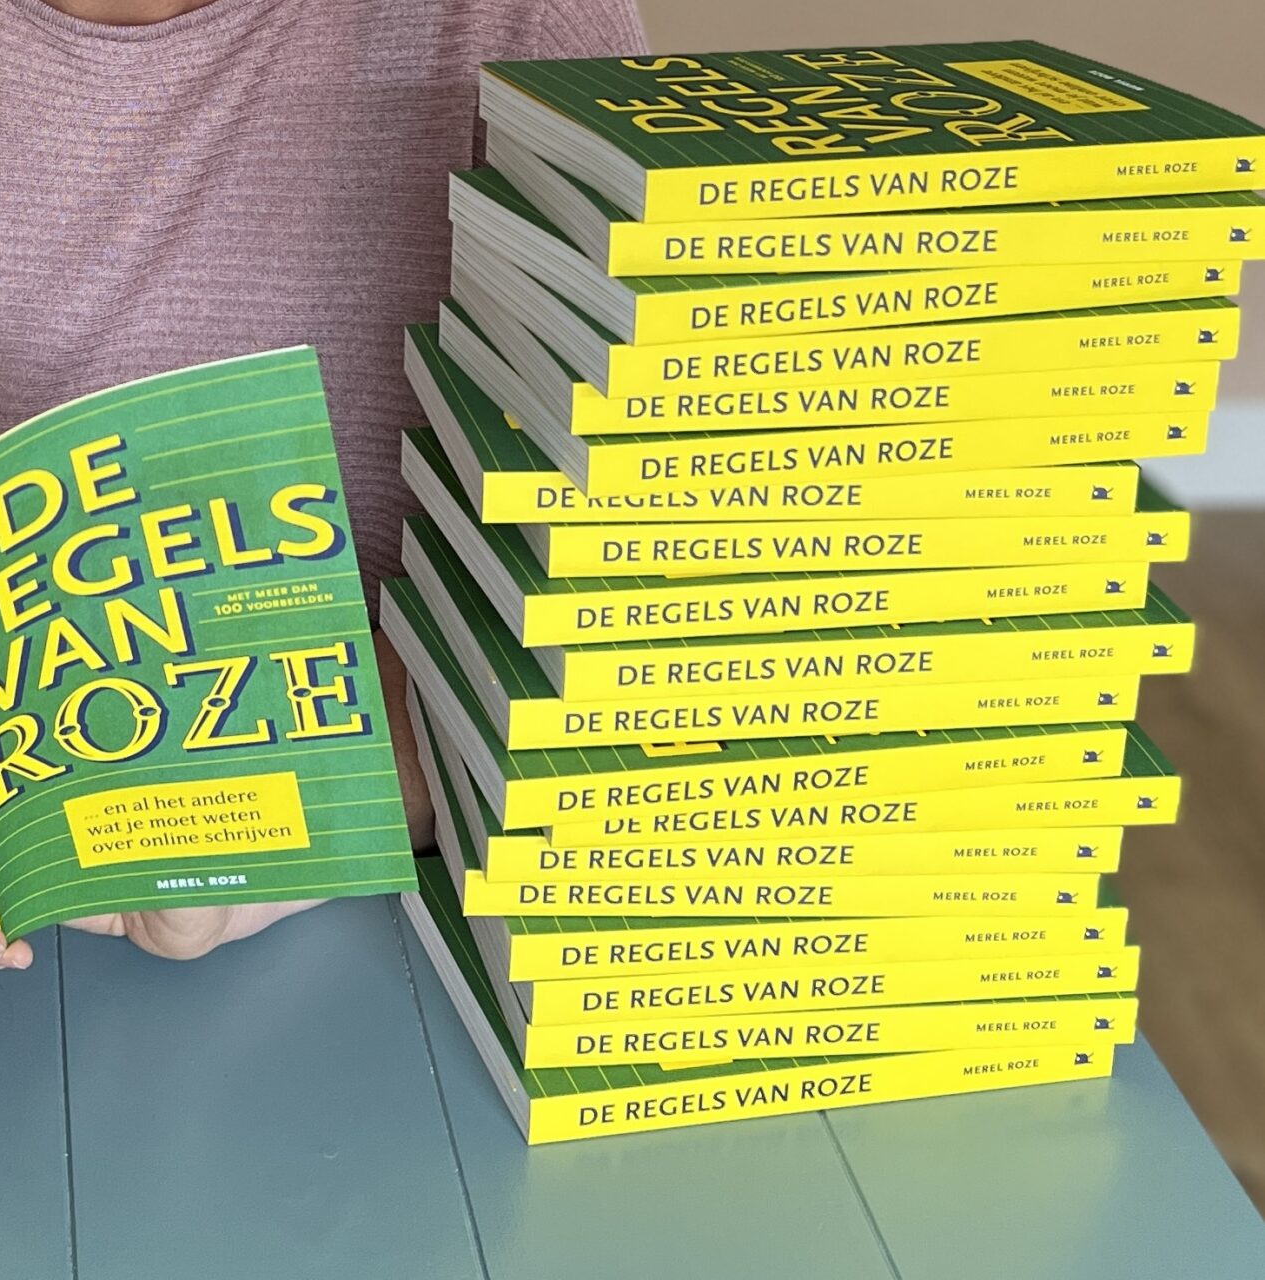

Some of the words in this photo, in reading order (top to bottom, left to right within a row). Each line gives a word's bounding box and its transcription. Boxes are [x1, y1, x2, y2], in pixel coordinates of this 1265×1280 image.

[595, 96, 725, 134] DE
[621, 56, 865, 156] REGELS
[767, 85, 932, 143] VAN
[783, 50, 1074, 146] ROZE
[699, 181, 738, 206] DE
[750, 174, 860, 203] REGELS
[870, 171, 928, 197] VAN
[941, 166, 1019, 192] ROZE
[1116, 164, 1160, 176] MEREL
[1163, 162, 1198, 174] ROZE
[665, 237, 705, 260] DE
[717, 233, 832, 259] REGELS
[842, 232, 903, 256] VAN
[917, 229, 998, 254] ROZE
[1102, 231, 1148, 243] MEREL
[1152, 230, 1189, 242] ROZE
[663, 356, 702, 381] DE
[713, 349, 823, 378] REGELS
[833, 345, 891, 370] VAN
[904, 339, 981, 366] ROZE
[1079, 336, 1122, 349] MEREL
[1126, 334, 1160, 345] ROZE
[641, 456, 679, 480] DE
[690, 448, 798, 477] REGELS
[807, 443, 865, 469] VAN
[878, 437, 954, 464] ROZE
[1049, 433, 1092, 445] MEREL
[1096, 430, 1130, 442] ROZE
[603, 540, 641, 562] DE
[653, 537, 763, 561] REGELS
[772, 536, 831, 559] VAN
[844, 534, 923, 556] ROZE
[1023, 535, 1067, 546] MEREL
[1072, 534, 1107, 545] ROZE
[213, 603, 243, 616] 100
[246, 593, 334, 612] VOORBEELDEN
[227, 592, 251, 602] MET
[254, 587, 288, 599] MEER
[291, 583, 318, 594] DAN
[565, 712, 603, 734] DE
[614, 706, 722, 732] REGELS
[731, 703, 790, 726] VAN
[802, 699, 879, 723] ROZE
[977, 698, 1021, 709] MEREL
[1025, 695, 1060, 707] ROZE
[104, 802, 127, 816] en
[133, 797, 149, 812] al
[154, 795, 186, 810] het
[191, 790, 258, 808] andere
[87, 822, 122, 837] wat
[126, 818, 144, 835] je
[149, 814, 196, 829] moet
[203, 810, 261, 825] weten
[92, 839, 134, 854] over
[140, 833, 199, 849] online
[204, 825, 292, 845] schrijven
[156, 877, 204, 890] MEREL
[208, 874, 248, 886] ROZE
[519, 884, 557, 904] DE
[568, 885, 676, 905] REGELS
[685, 885, 743, 905] VAN
[755, 885, 833, 905] ROZE
[933, 891, 977, 901] MEREL
[981, 891, 1017, 901] ROZE
[579, 1104, 615, 1126] DE
[625, 1090, 727, 1121] REGELS
[735, 1083, 789, 1108] VAN
[800, 1073, 872, 1100] ROZE
[963, 1063, 1003, 1076] MEREL
[1007, 1059, 1039, 1071] ROZE
